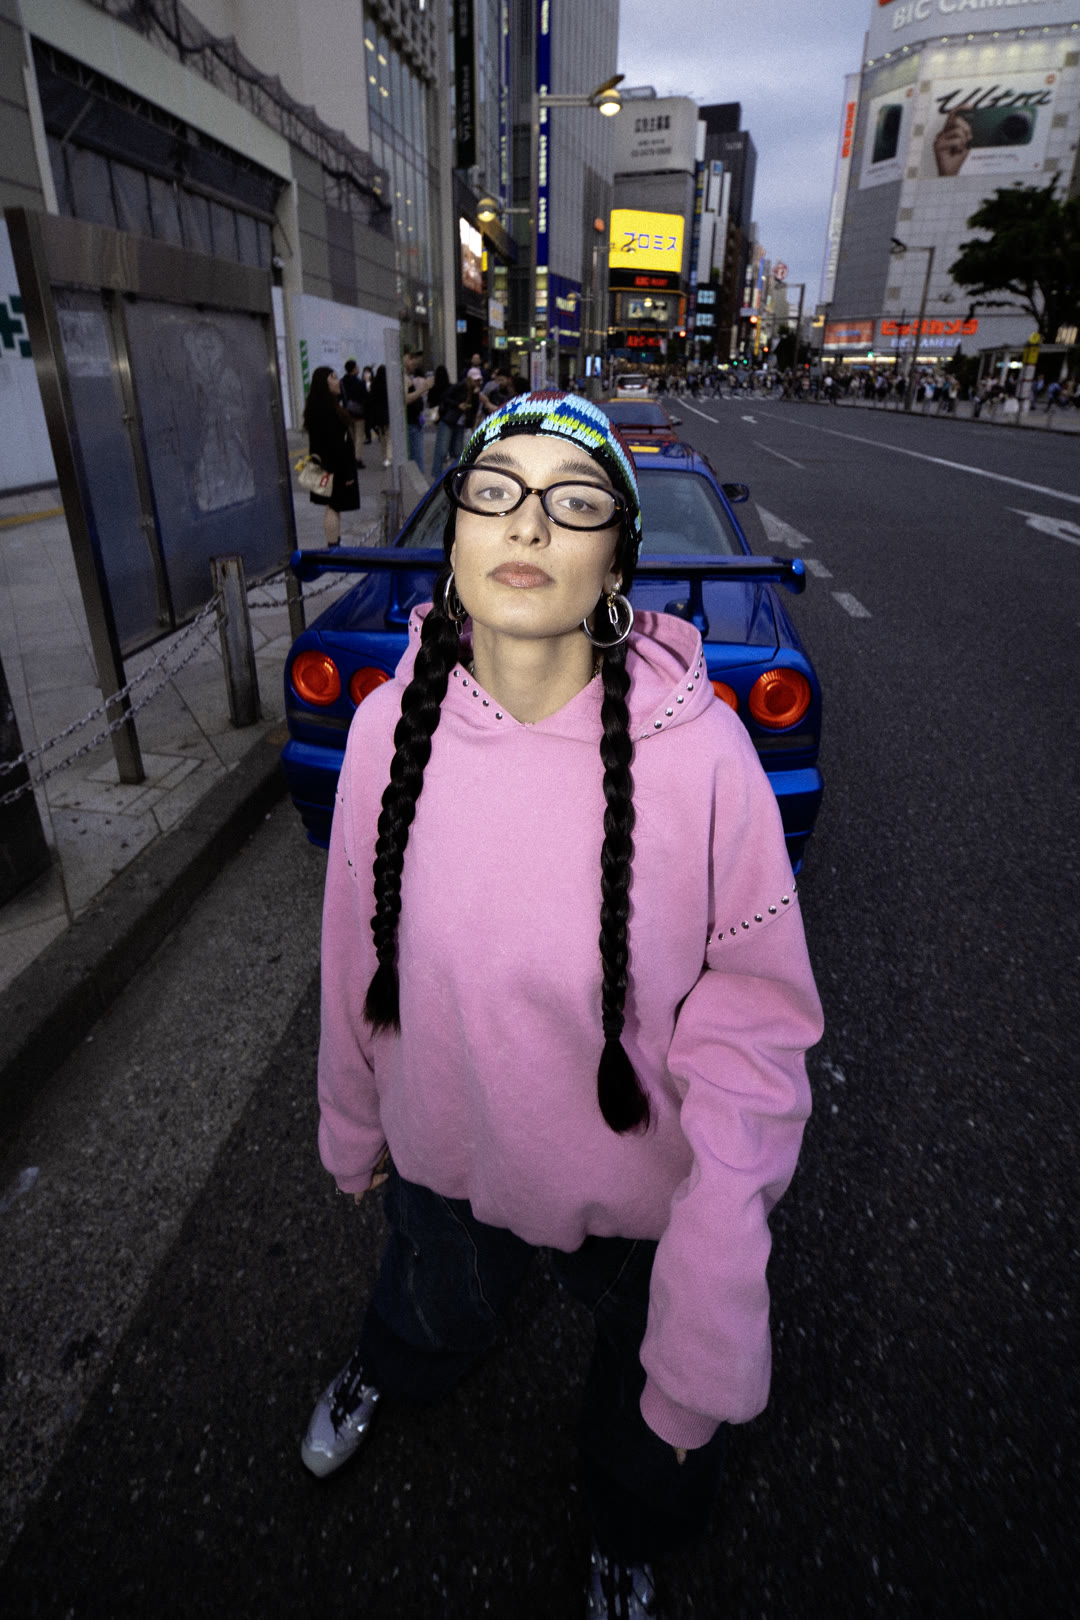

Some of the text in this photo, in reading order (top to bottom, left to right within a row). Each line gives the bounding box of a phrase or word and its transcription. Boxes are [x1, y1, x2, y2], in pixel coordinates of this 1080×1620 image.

[893, 0, 931, 30] BIC
[935, 84, 1053, 114] Ultra
[622, 231, 678, 252] プロミス
